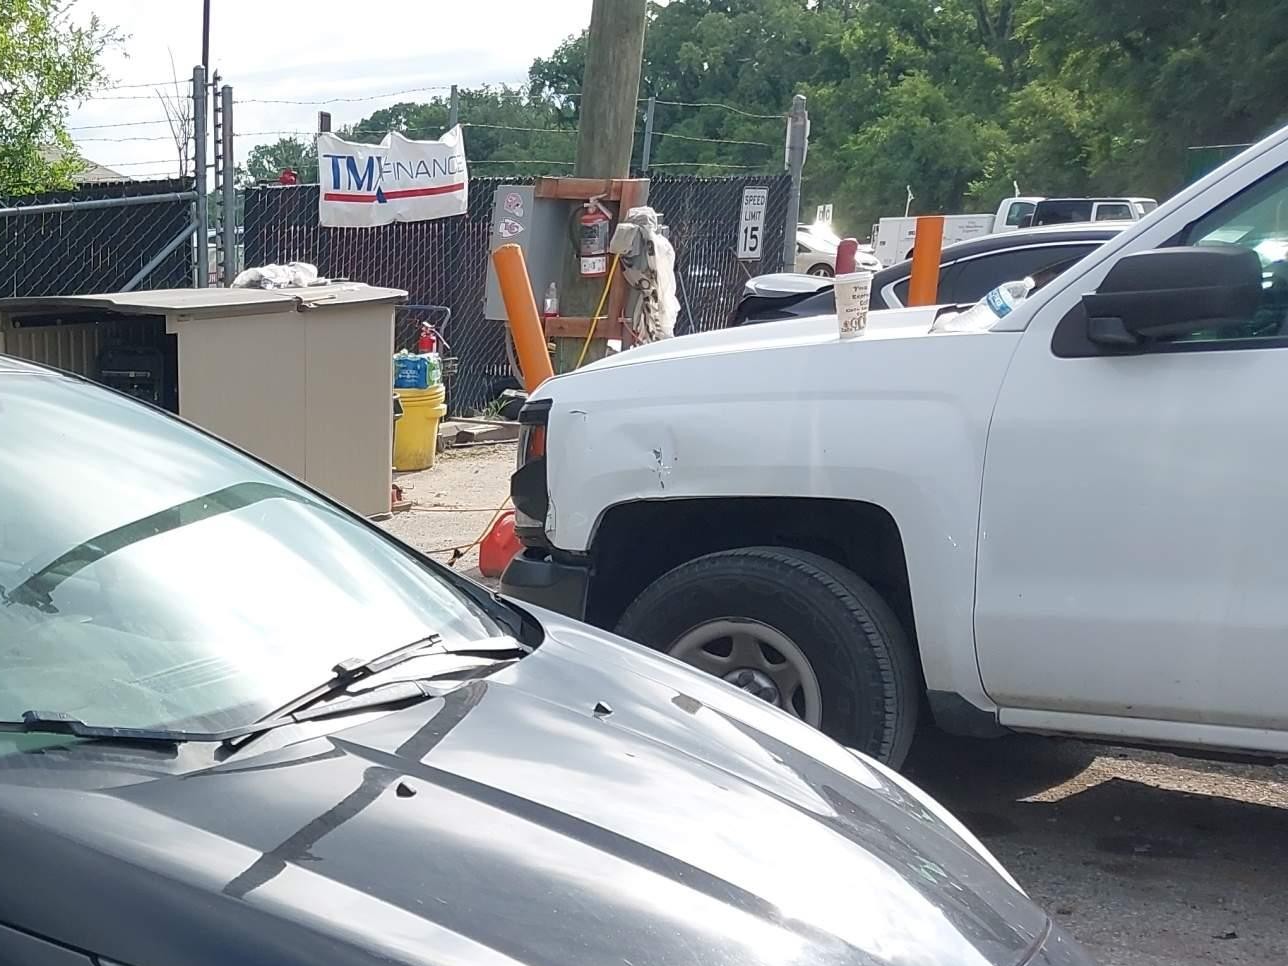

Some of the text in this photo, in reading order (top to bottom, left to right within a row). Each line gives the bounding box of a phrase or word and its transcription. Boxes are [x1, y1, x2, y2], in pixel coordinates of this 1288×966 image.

[380, 154, 465, 182] FINANCE
[744, 195, 766, 206] SPEED
[744, 210, 762, 221] LIMIT
[743, 226, 760, 252] 15
